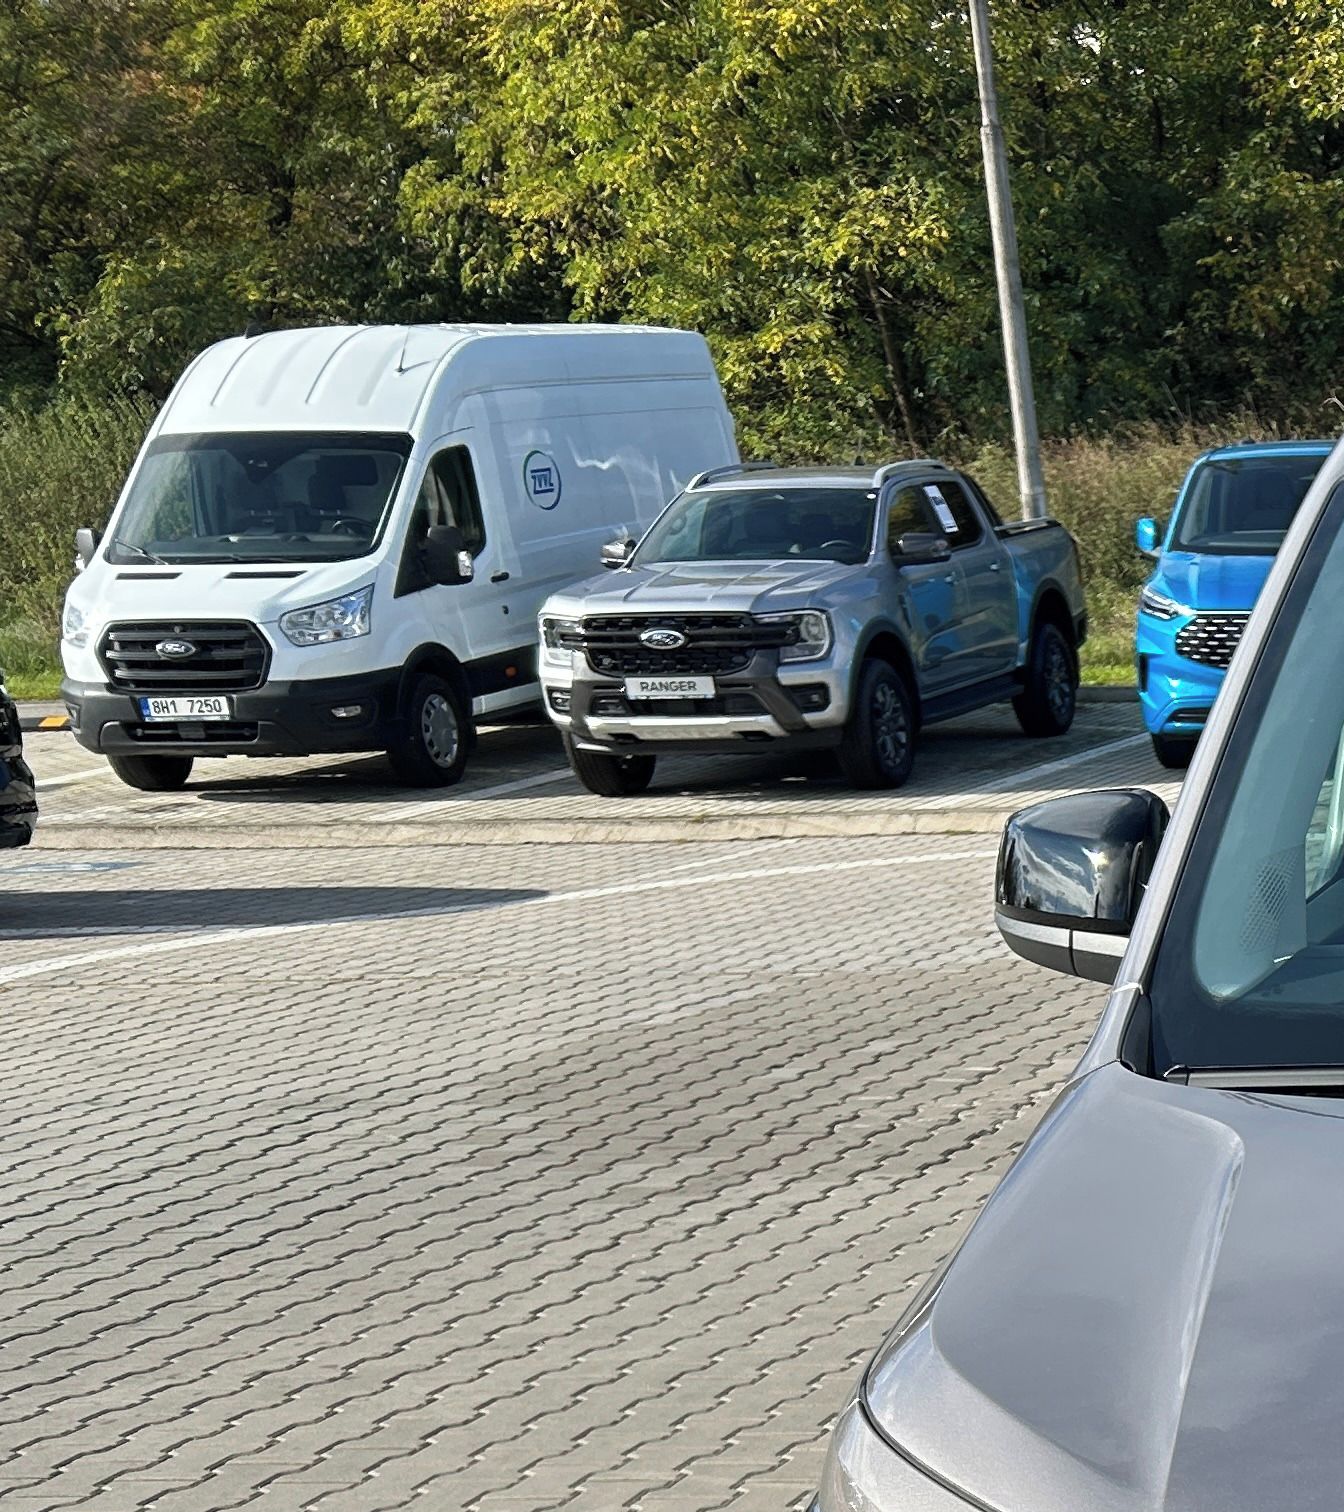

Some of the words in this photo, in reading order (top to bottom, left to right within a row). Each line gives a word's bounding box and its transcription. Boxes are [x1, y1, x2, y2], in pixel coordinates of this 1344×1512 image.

[639, 681, 697, 692] RANGER
[152, 700, 178, 714] 8H1
[187, 699, 222, 713] 7250
